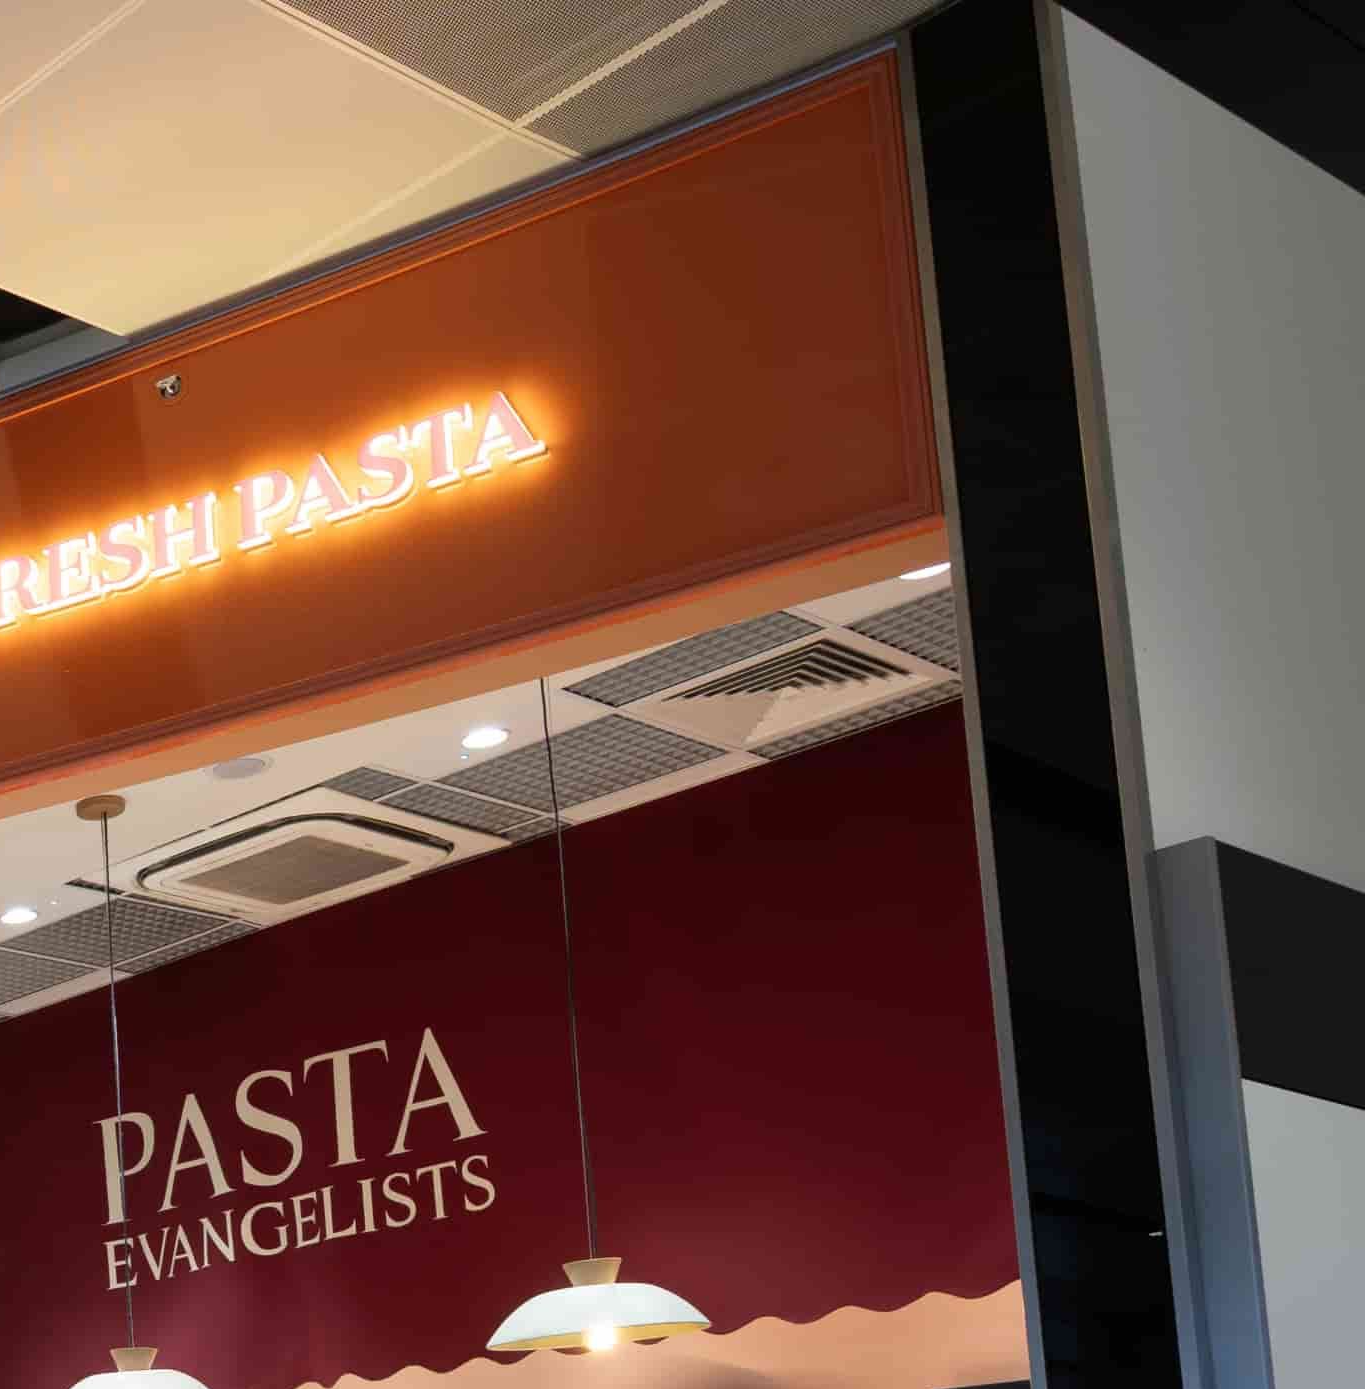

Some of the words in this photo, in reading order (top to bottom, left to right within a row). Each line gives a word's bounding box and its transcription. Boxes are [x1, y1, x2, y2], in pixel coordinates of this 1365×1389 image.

[233, 391, 548, 552] PASTA
[92, 1028, 488, 1226] PASTA
[104, 1155, 495, 1290] EVANGELISTS
